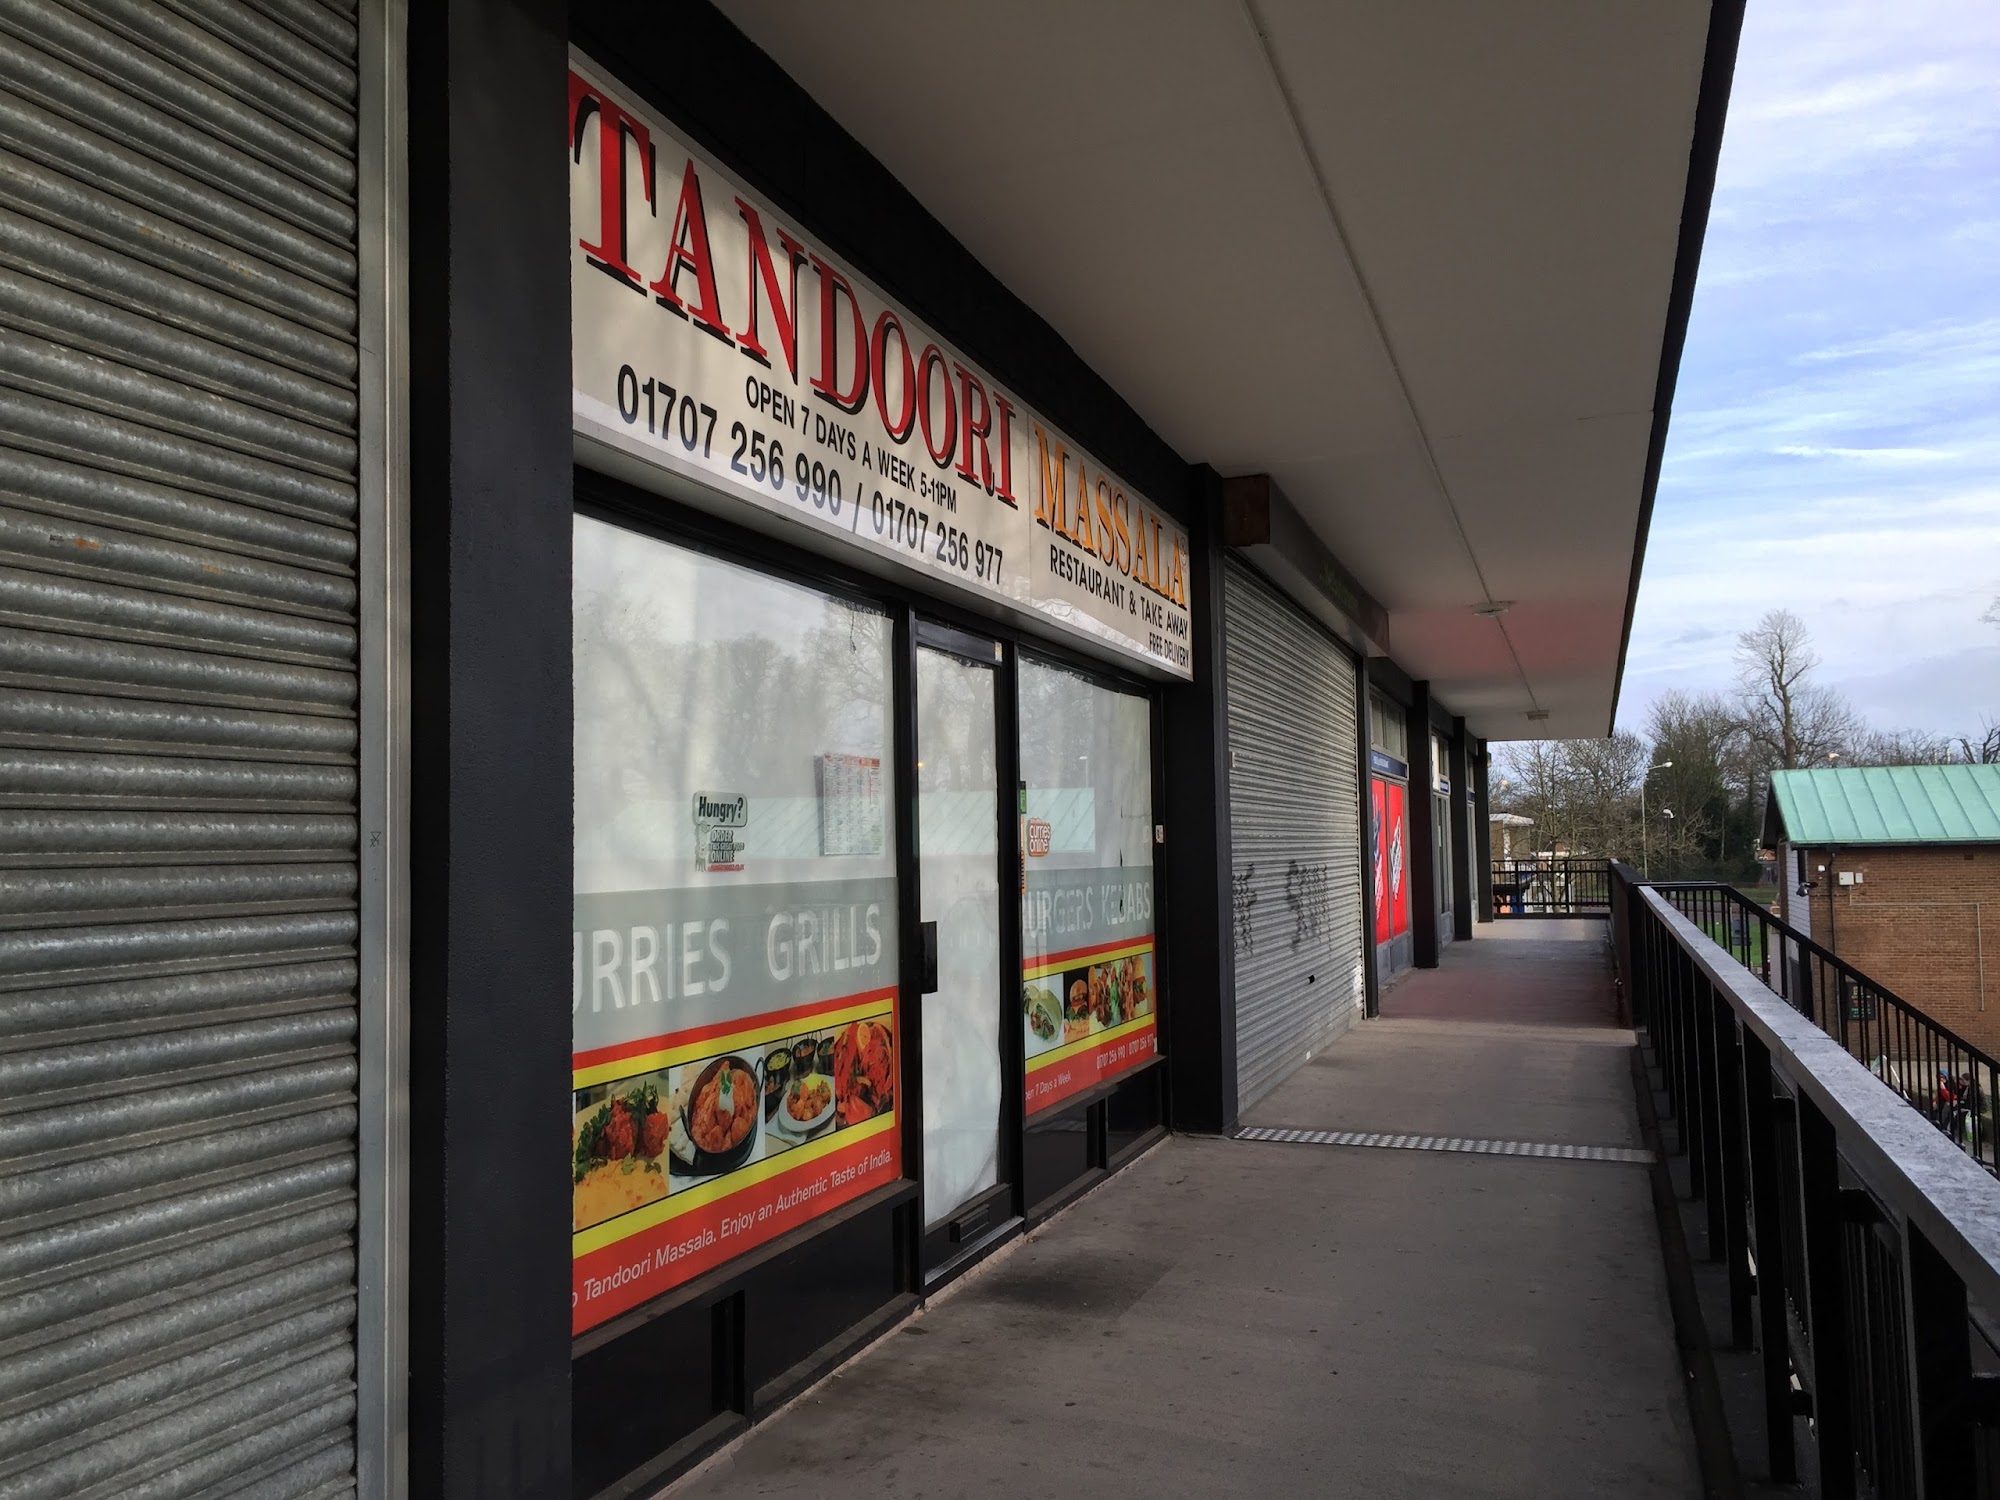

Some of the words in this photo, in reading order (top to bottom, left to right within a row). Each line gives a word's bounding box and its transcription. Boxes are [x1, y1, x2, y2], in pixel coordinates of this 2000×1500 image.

[568, 69, 1019, 511] TANDOORI
[617, 364, 717, 458] 01707
[730, 422, 785, 490] 256
[794, 452, 842, 516] 990
[852, 481, 863, 534] /
[872, 490, 929, 554] 01707
[936, 521, 969, 571] 256
[975, 539, 1004, 585] 977
[746, 376, 795, 430] OPEN
[800, 404, 809, 436] 7
[815, 414, 857, 461] DAYS
[862, 441, 872, 470] A
[878, 447, 915, 492] WEEK
[919, 472, 957, 514] 5-11PM
[1034, 421, 1188, 611] MASSALA
[1050, 543, 1125, 610] RESTAURANT
[1129, 590, 1137, 615] &
[1141, 596, 1163, 629] TAKE
[1166, 606, 1189, 641] AWAY
[1149, 632, 1163, 657] FREE
[1164, 639, 1190, 669] DELIVERY
[699, 796, 744, 823] Hungry?
[711, 830, 734, 843] ORDER
[711, 850, 734, 862] ONLINE
[573, 918, 732, 1013] RRIES
[767, 904, 882, 981] GRILLS
[584, 1252, 650, 1302] Tandoori
[655, 1227, 717, 1267] Massala.
[720, 1208, 756, 1240] Enjoy
[758, 1203, 773, 1221] an
[775, 1176, 828, 1214] Authentic
[830, 1165, 857, 1189] Taste
[857, 1157, 869, 1175] of
[869, 1149, 893, 1172] India.
